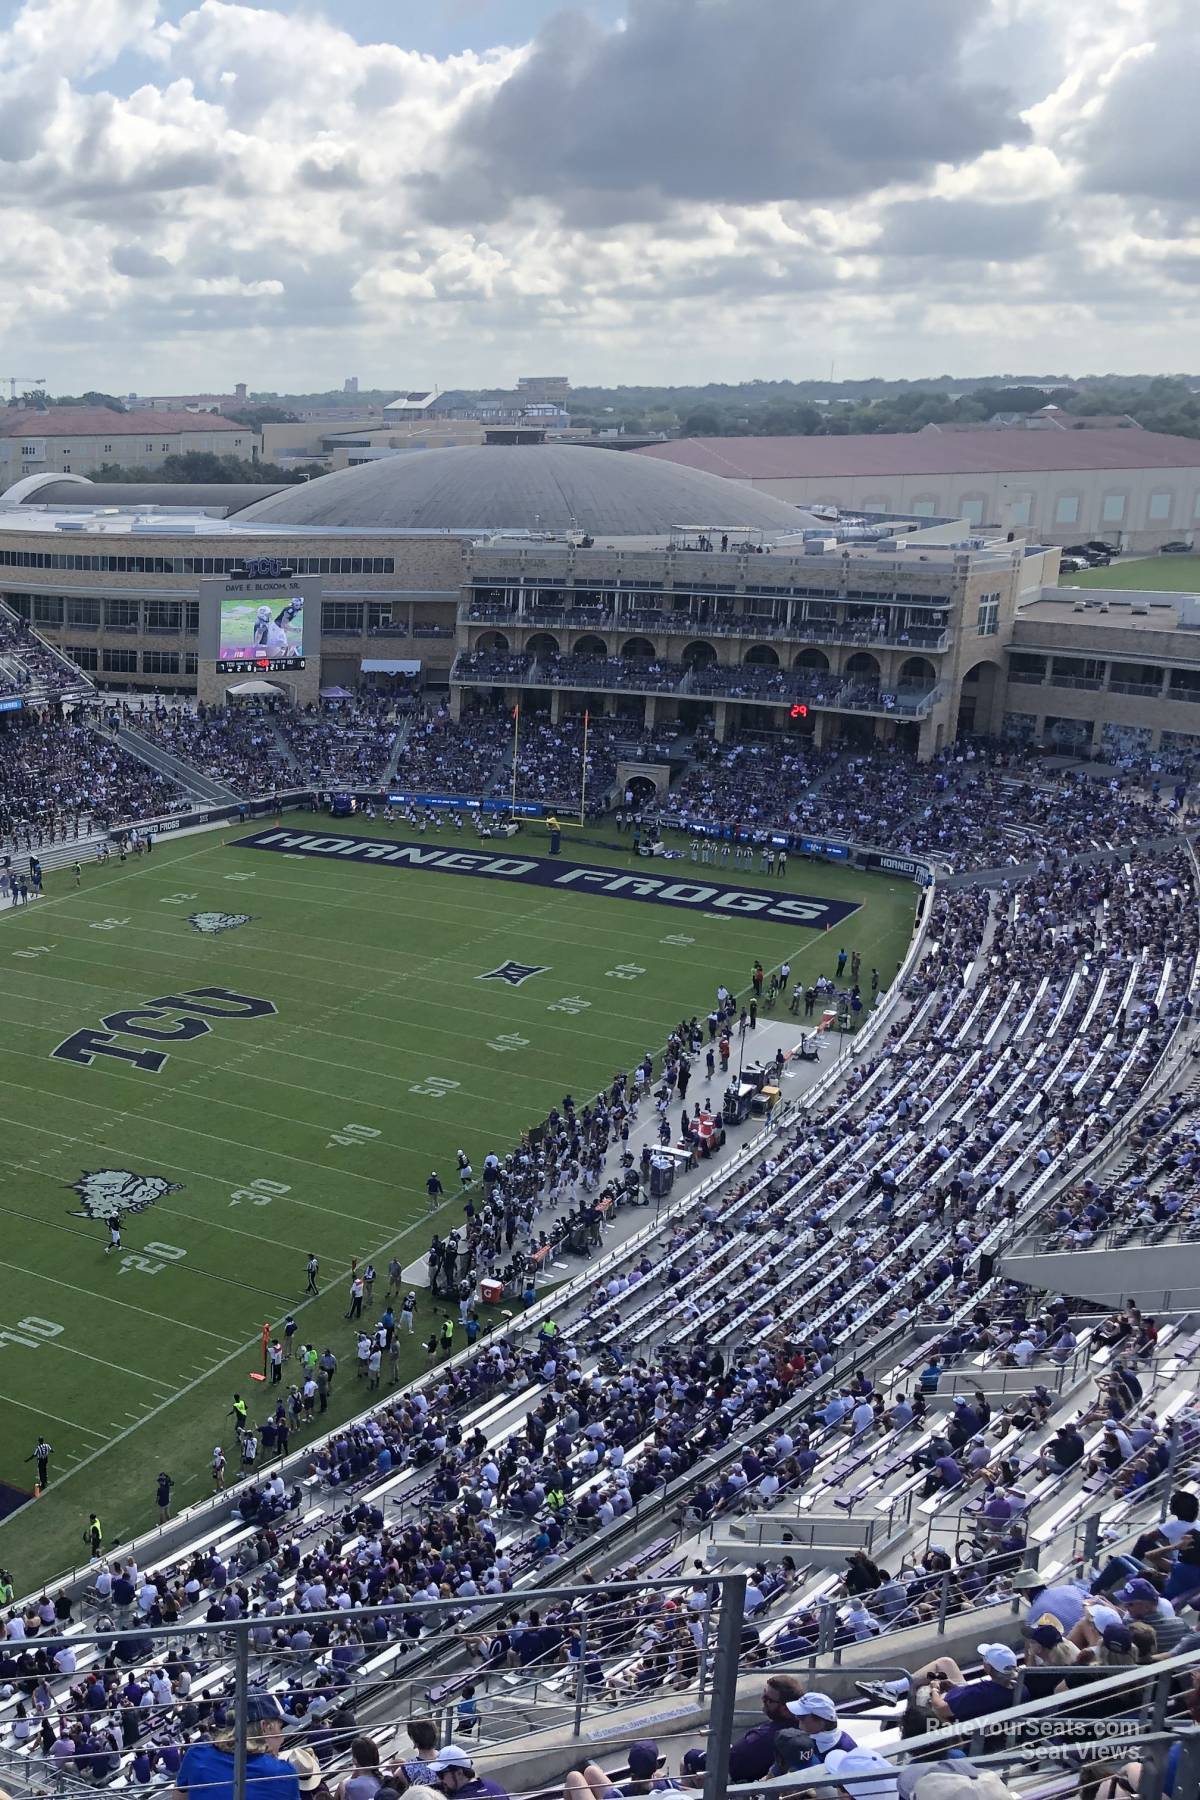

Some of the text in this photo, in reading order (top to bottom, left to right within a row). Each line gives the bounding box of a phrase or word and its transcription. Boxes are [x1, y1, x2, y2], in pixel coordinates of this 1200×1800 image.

[245, 558, 282, 579] TCU
[225, 584, 244, 592] DAVE
[790, 704, 808, 718] 29
[254, 831, 829, 920] HORNED FROGS
[880, 857, 915, 873] HORNED
[604, 964, 647, 980] 20
[547, 995, 593, 1016] 30
[49, 986, 279, 1074] TCU
[487, 1034, 531, 1053] 40
[409, 1076, 462, 1098] 50
[332, 1123, 382, 1146] 40
[240, 1178, 292, 1205] 30
[126, 1241, 188, 1273] 20
[483, 1289, 492, 1298] G
